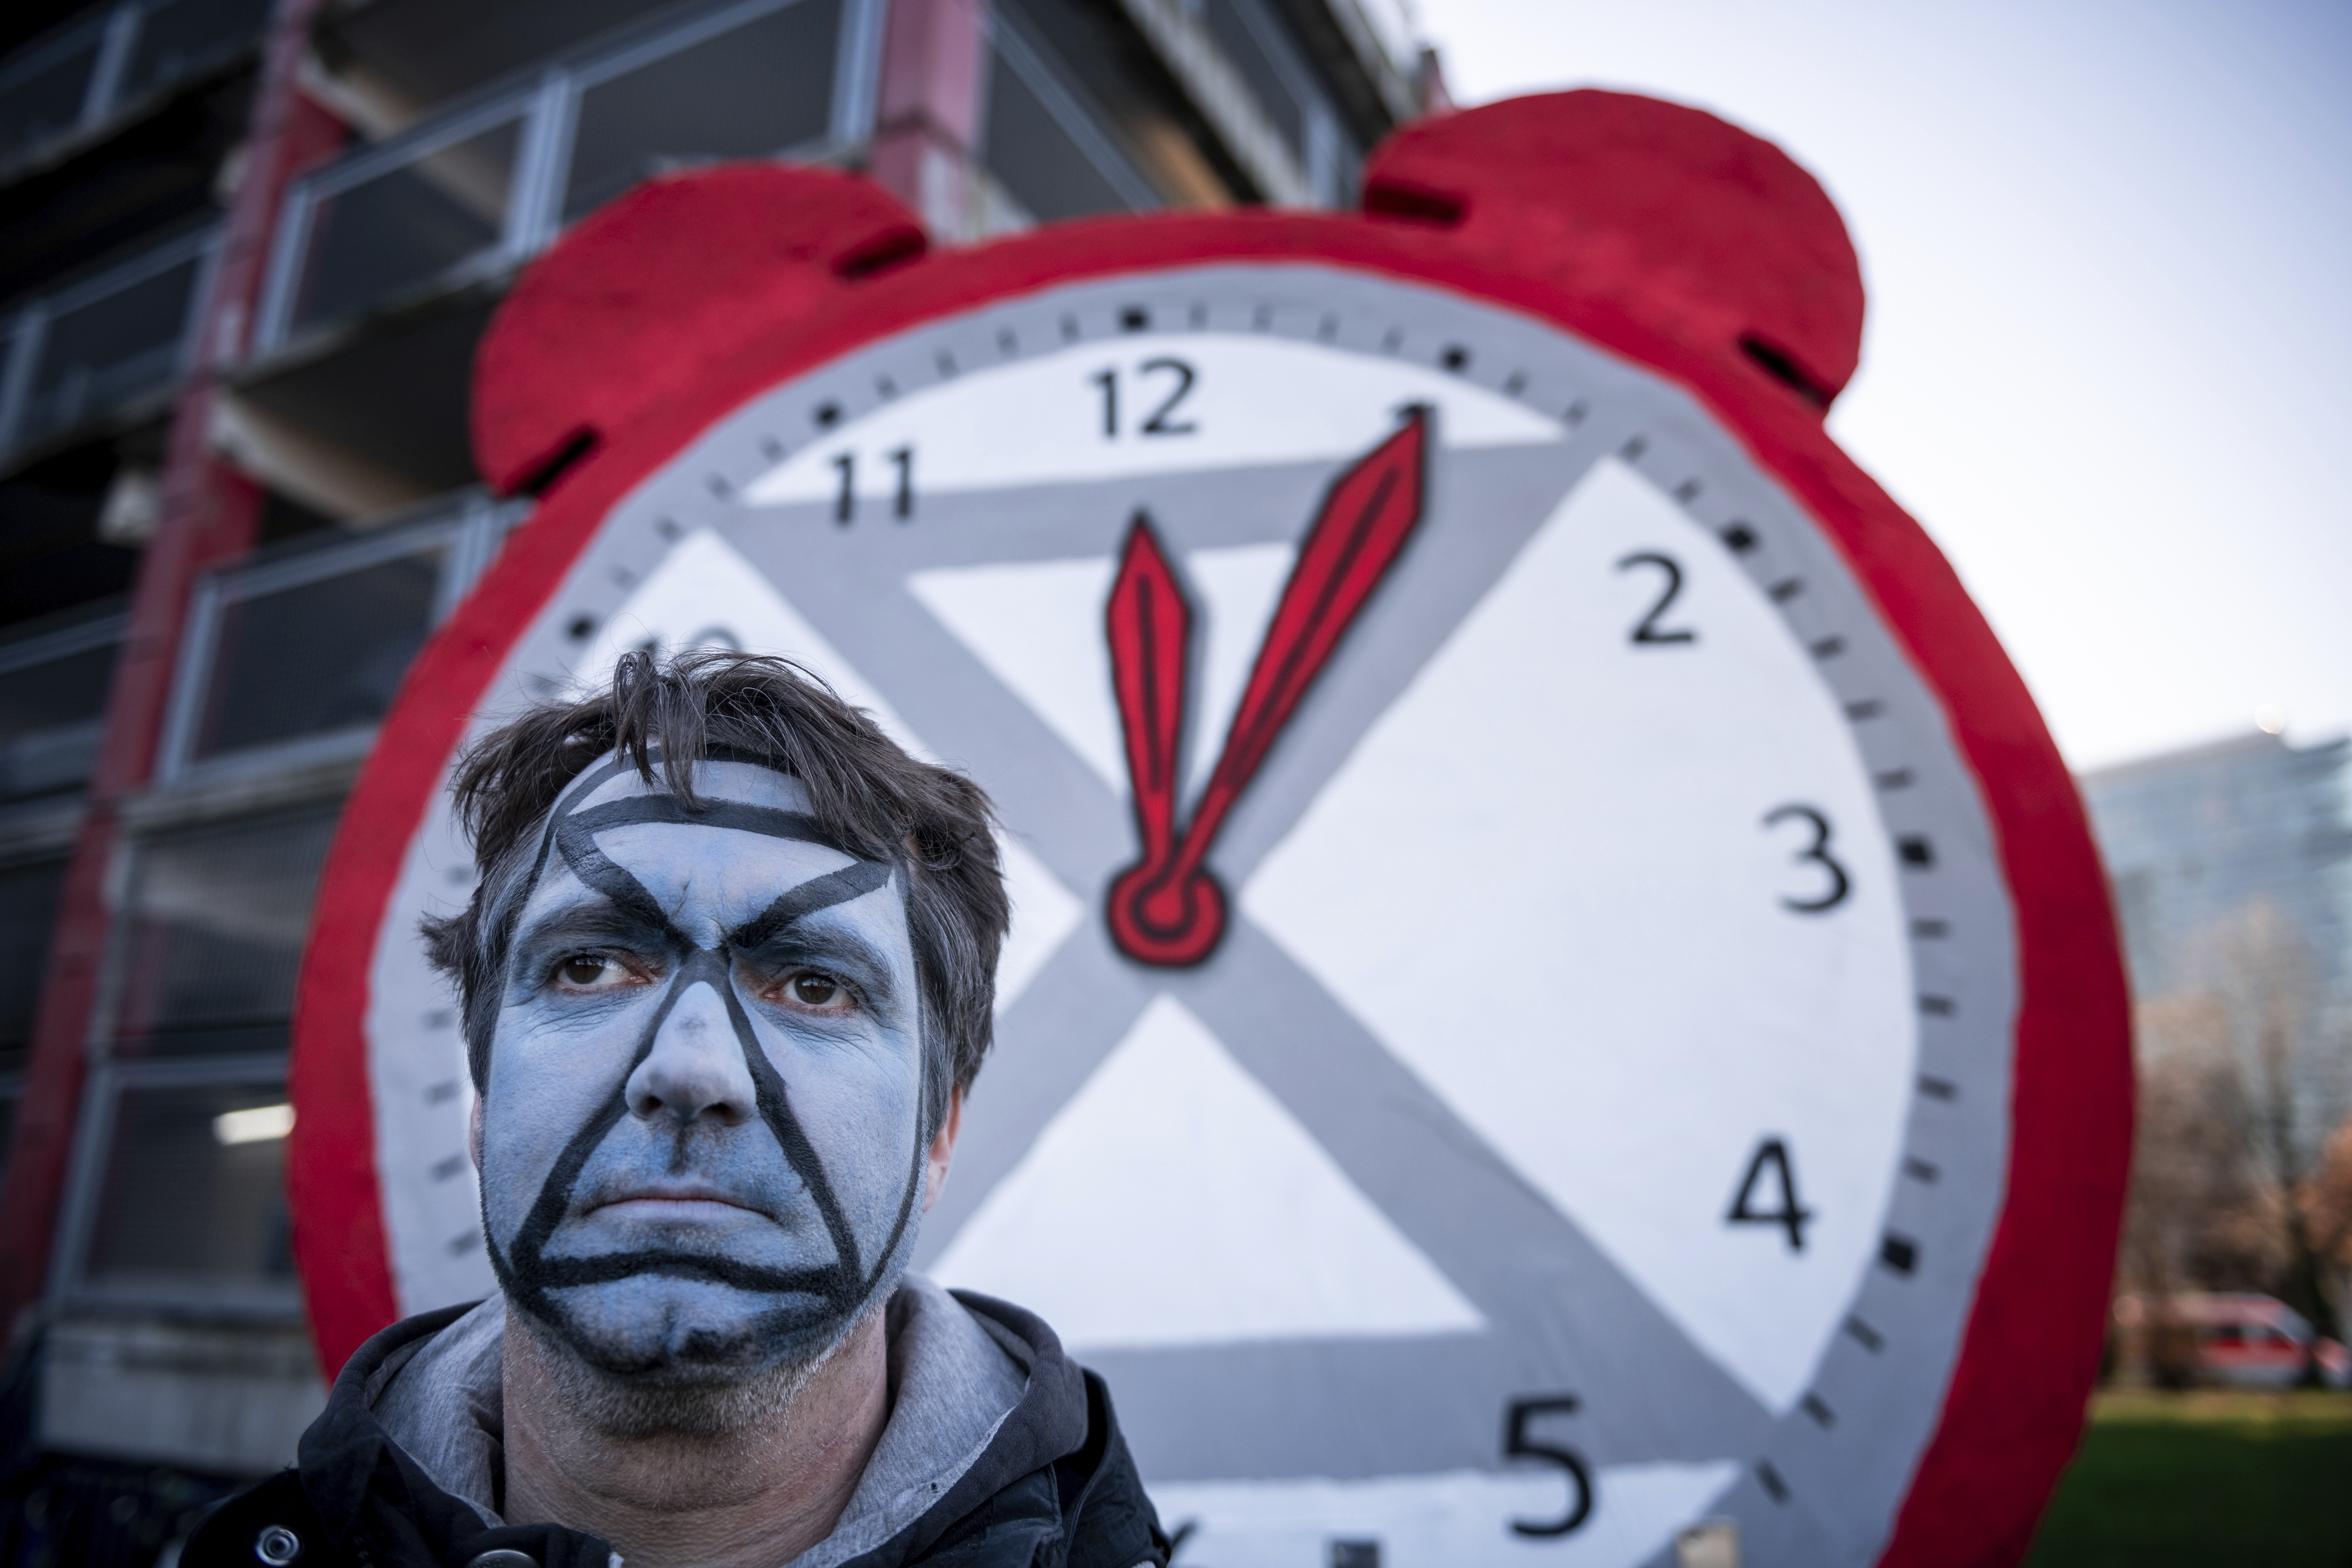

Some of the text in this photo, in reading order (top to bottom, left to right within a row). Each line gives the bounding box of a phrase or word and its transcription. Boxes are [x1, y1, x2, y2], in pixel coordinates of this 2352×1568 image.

[1089, 356, 1200, 438] 12
[828, 446, 916, 526] 11
[1614, 550, 1697, 646] 2
[1763, 805, 1852, 913] 3
[1723, 1136, 1814, 1252] 4
[1501, 1393, 1595, 1539] 5
